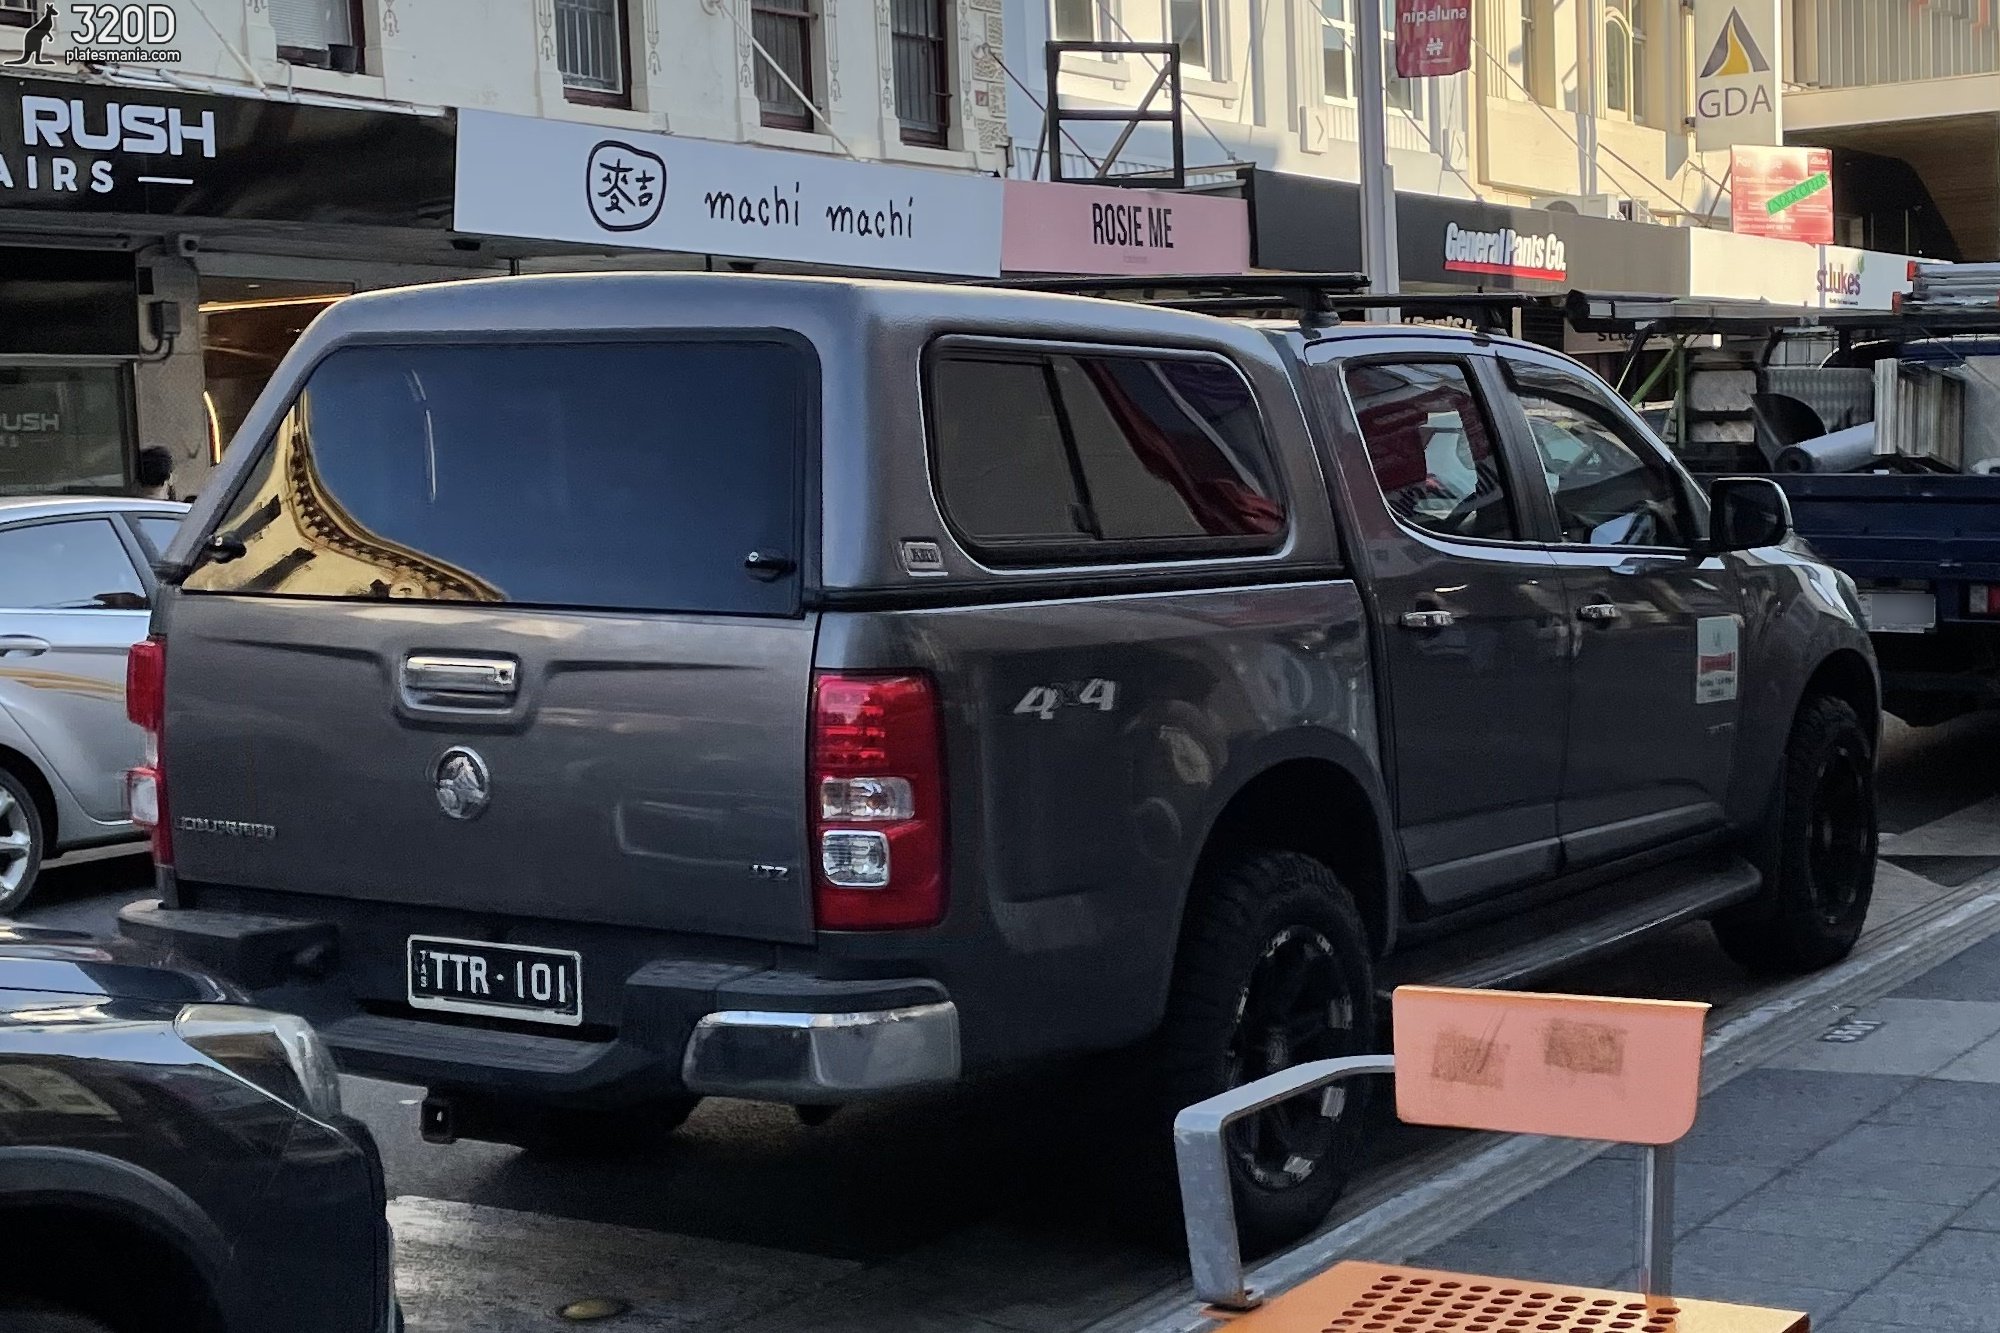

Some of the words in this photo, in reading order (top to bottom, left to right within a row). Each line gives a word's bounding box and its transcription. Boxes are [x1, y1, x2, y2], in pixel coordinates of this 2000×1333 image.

[1402, 5, 1467, 26] nipaluna
[1698, 84, 1772, 118] GDA
[22, 95, 216, 158] RUSH
[705, 182, 800, 227] machi
[826, 197, 914, 239] machi
[1092, 203, 1144, 247] ROSIE
[1148, 207, 1174, 248] ME
[1445, 222, 1506, 265] General
[1507, 228, 1546, 269] Pants
[1545, 233, 1567, 271] Co.
[0, 413, 60, 431] USH
